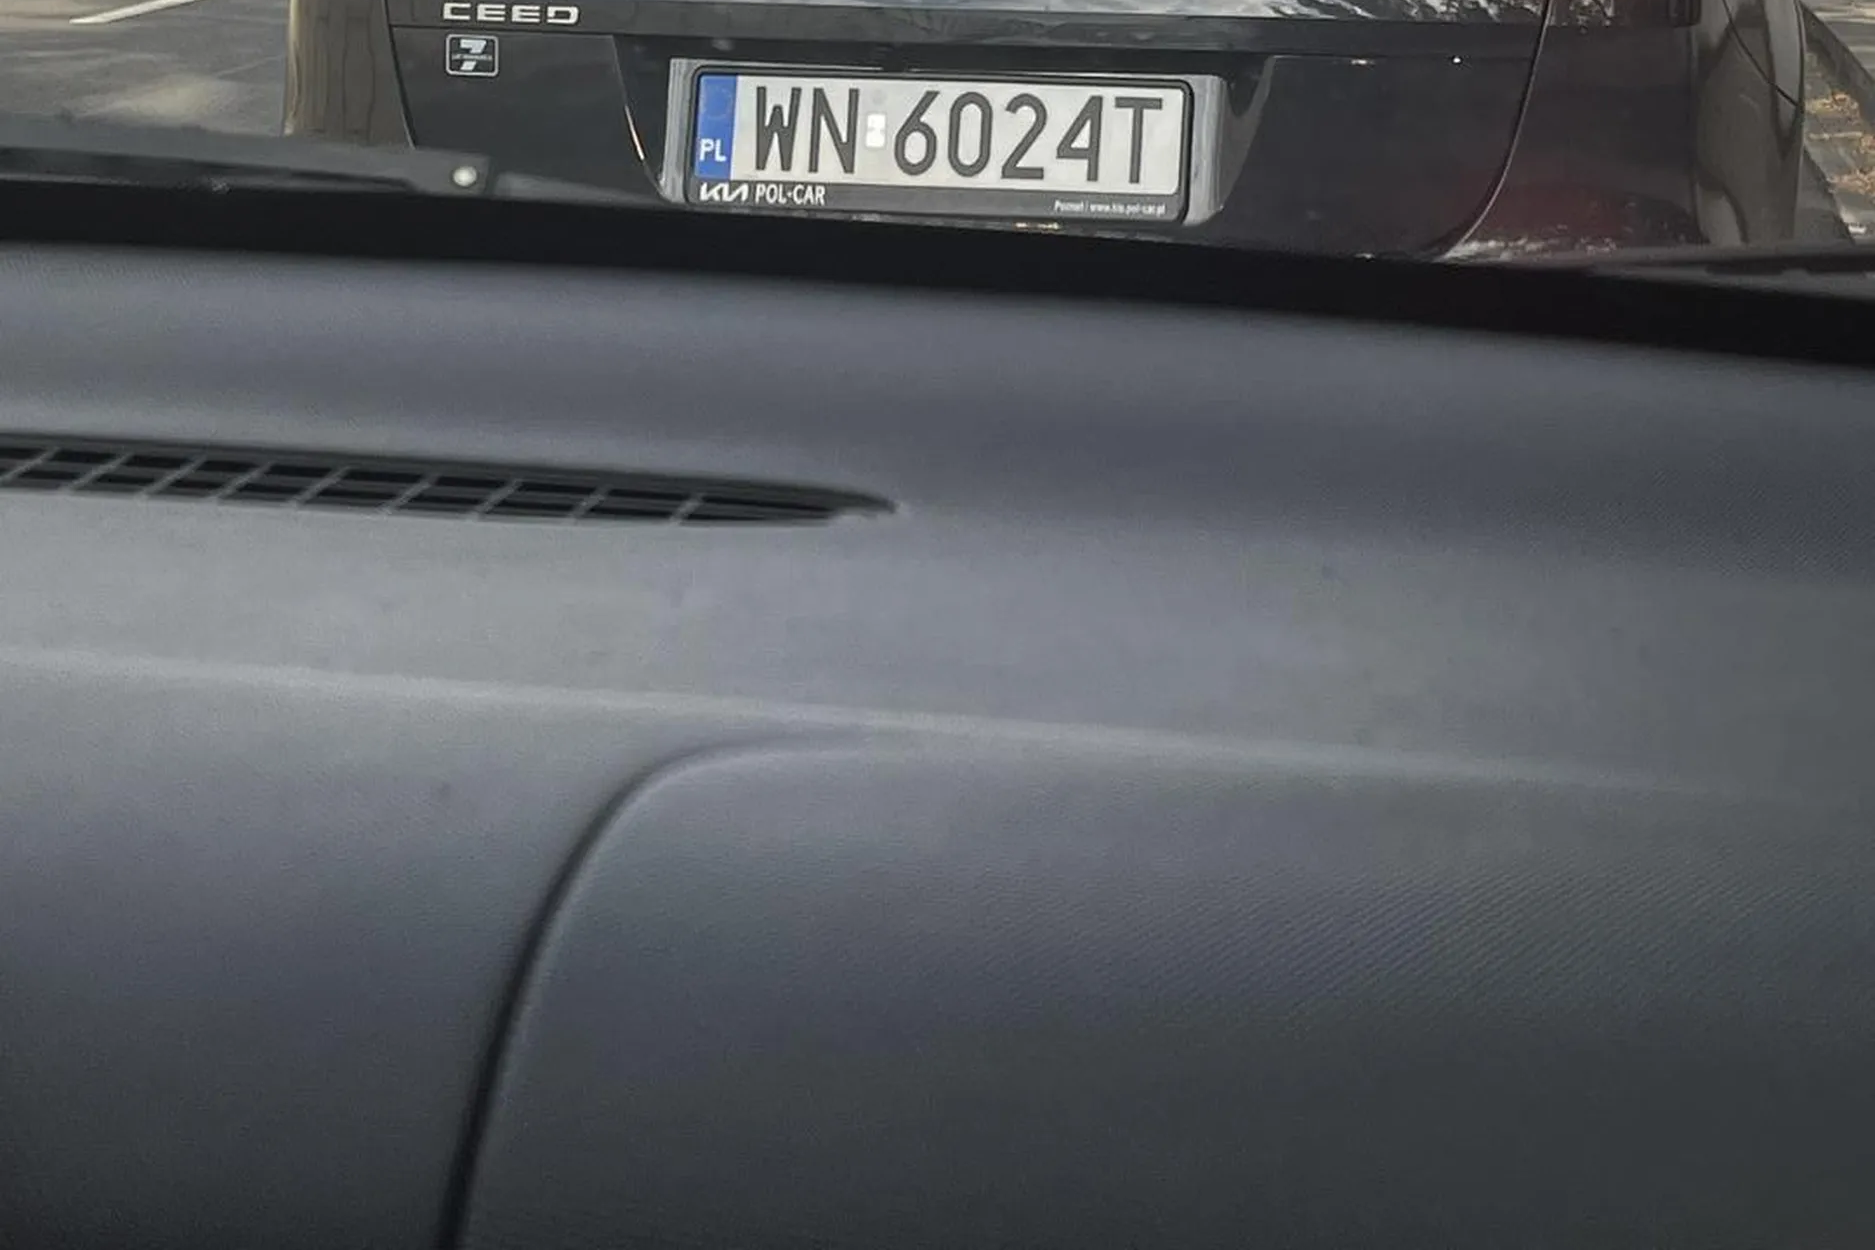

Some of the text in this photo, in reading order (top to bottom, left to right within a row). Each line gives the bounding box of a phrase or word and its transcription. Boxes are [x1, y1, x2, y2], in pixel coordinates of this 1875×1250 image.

[443, 2, 579, 25] CEED
[756, 86, 1163, 184] WN 6024T
[700, 138, 727, 163] PL
[700, 182, 749, 202] KIA
